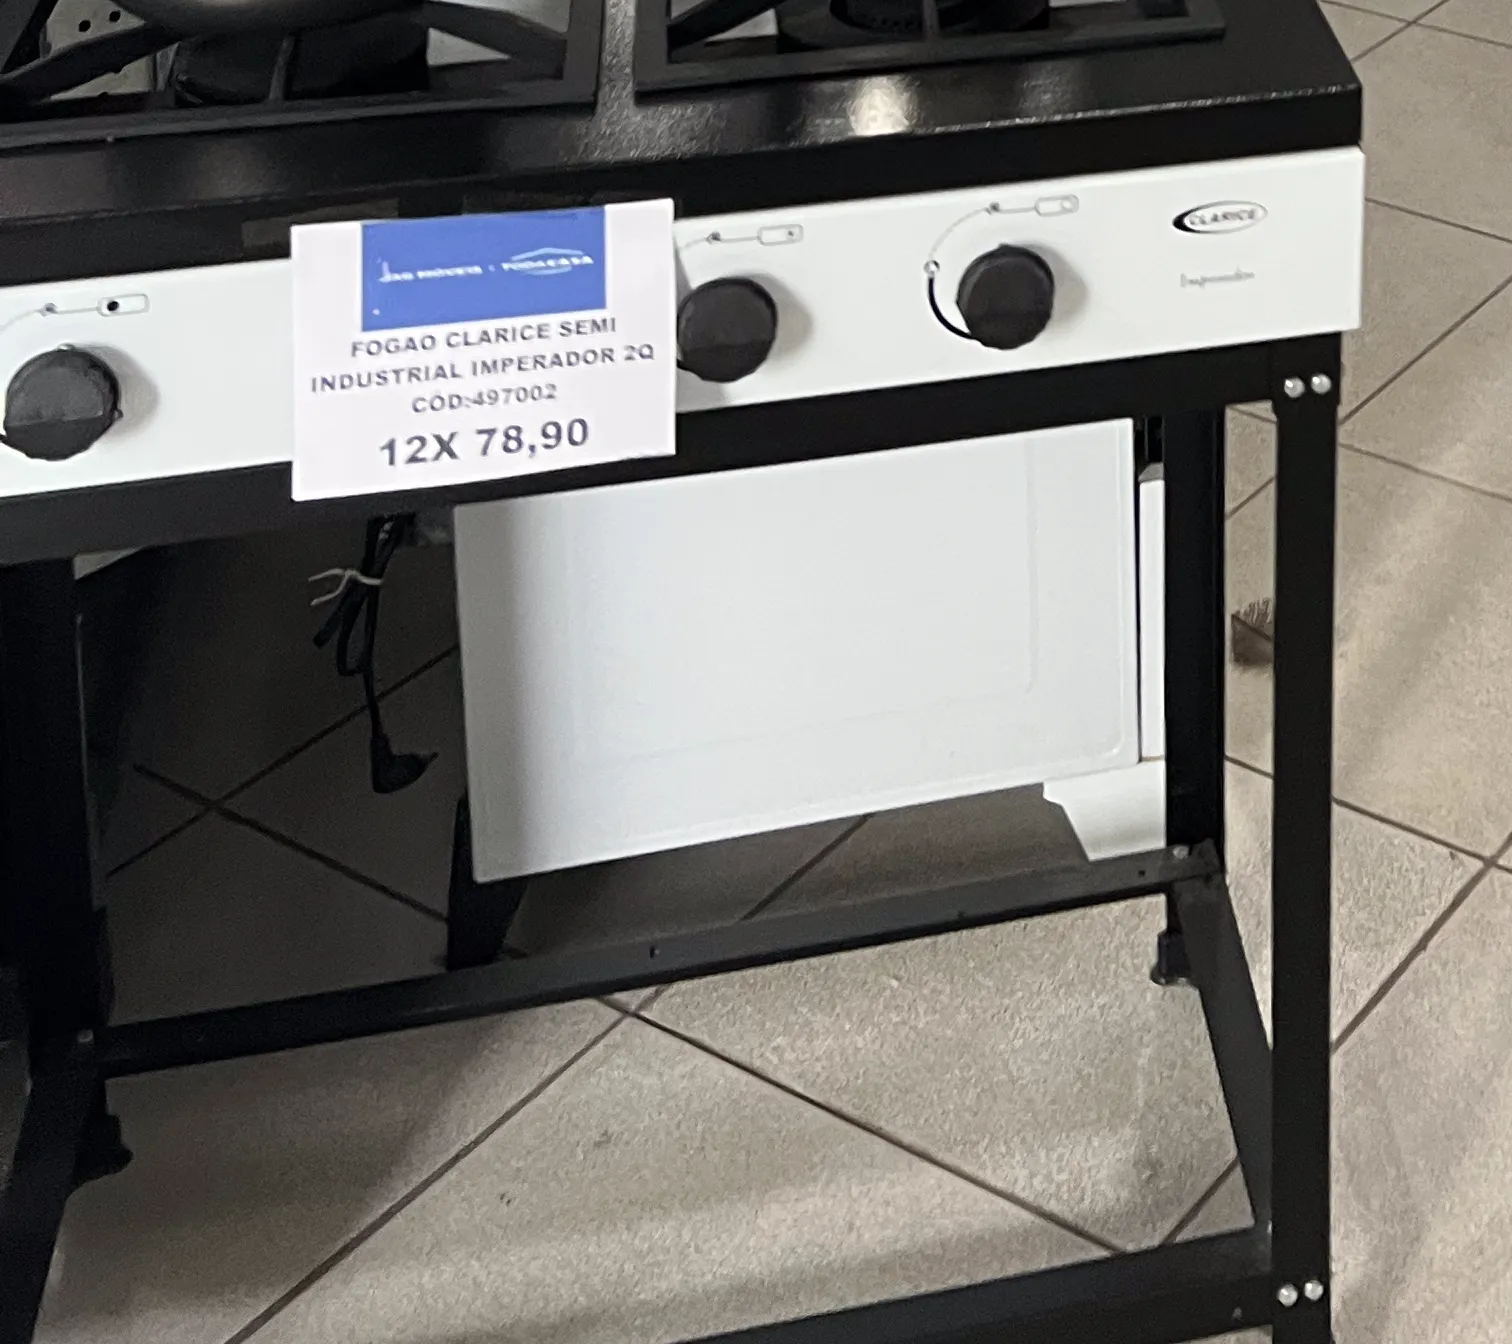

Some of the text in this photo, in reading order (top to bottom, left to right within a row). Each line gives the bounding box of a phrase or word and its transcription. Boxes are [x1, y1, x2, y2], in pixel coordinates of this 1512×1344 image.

[1187, 208, 1257, 226] CLARICE
[350, 317, 617, 358] FOGAO CLARICE SEMI
[311, 343, 655, 393] INDUSTRIAL IMPERADOR 2Q
[380, 417, 589, 468] 12X 78,90
